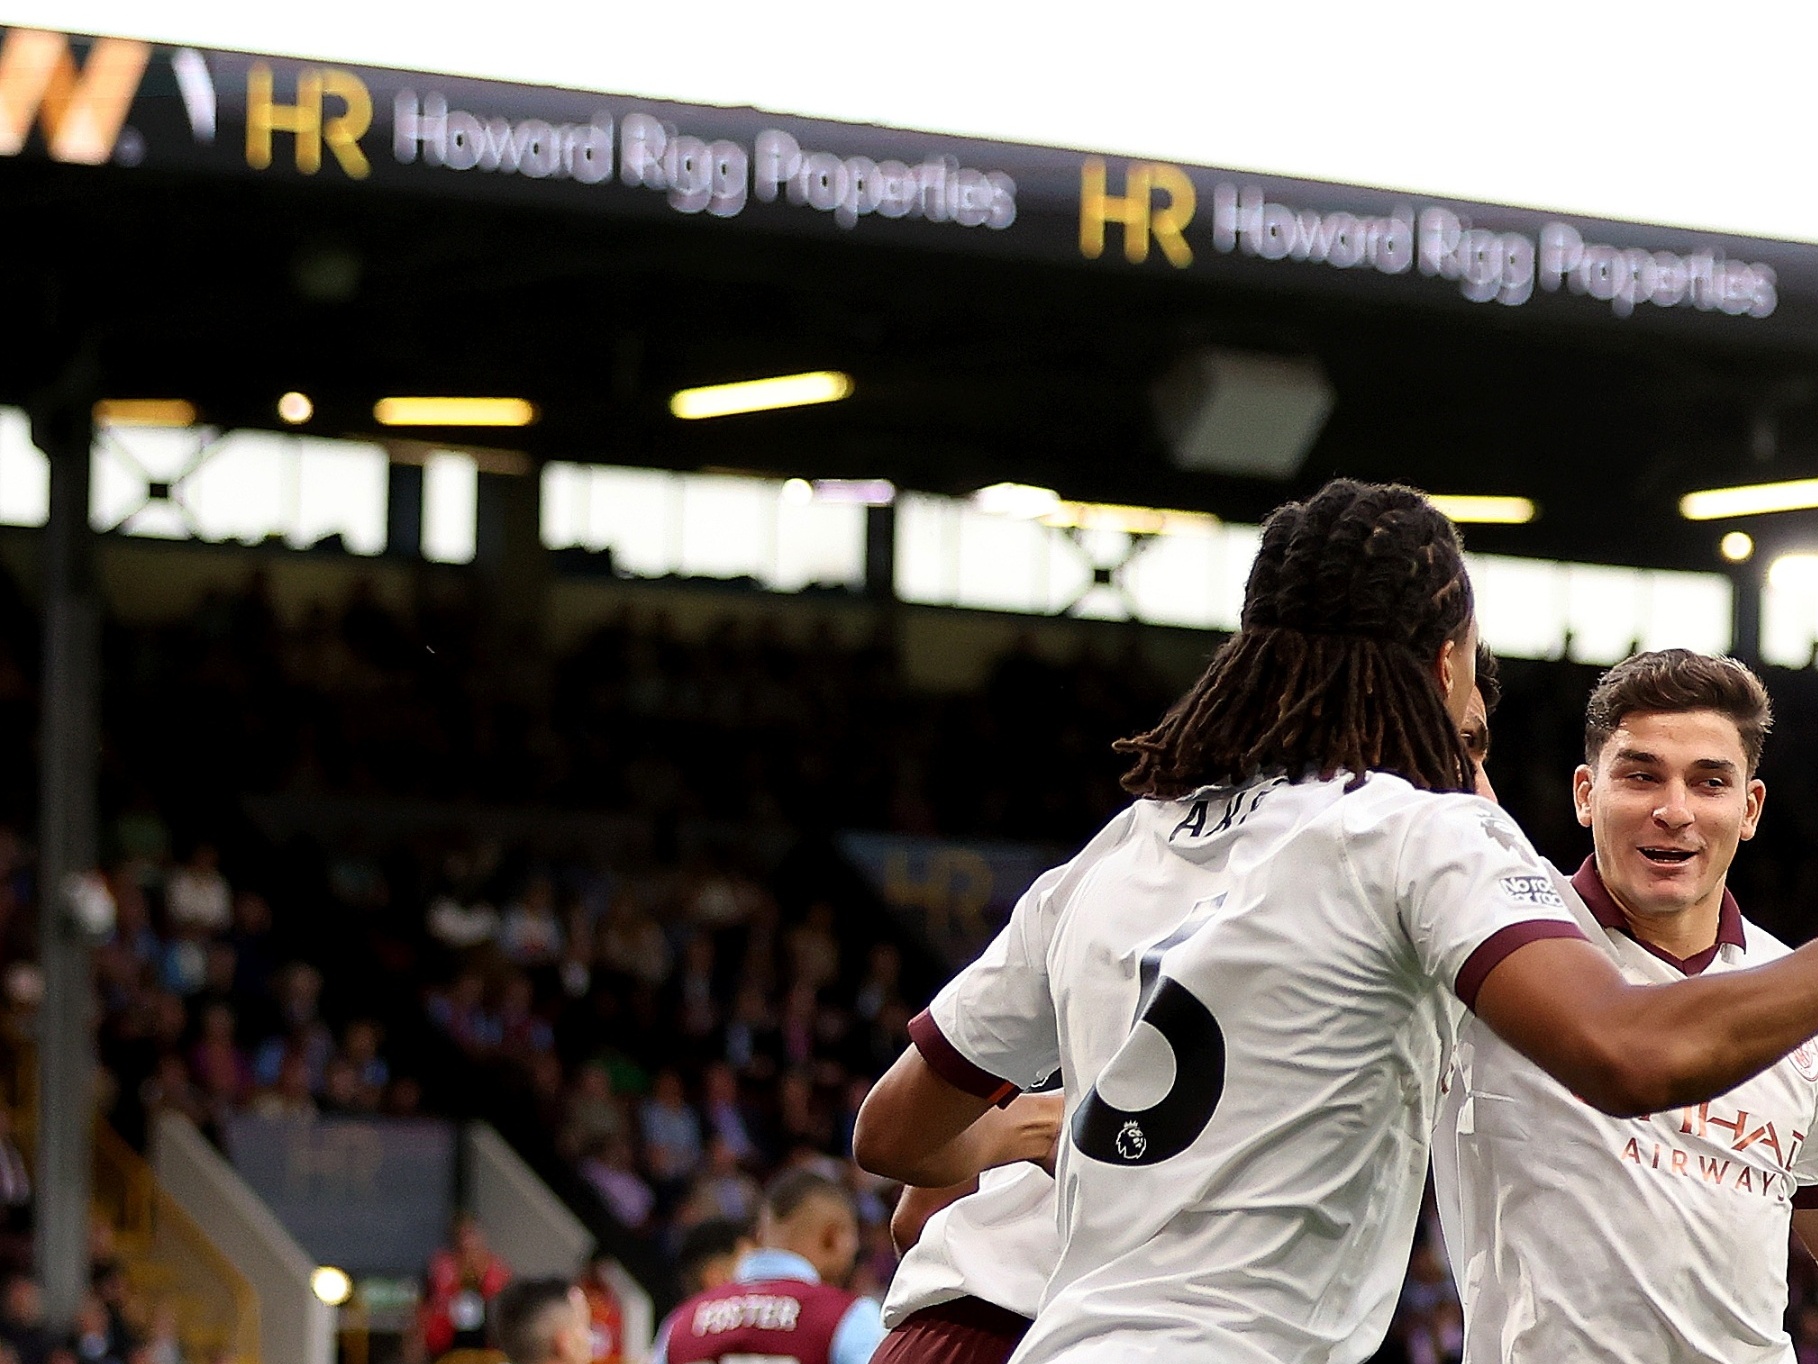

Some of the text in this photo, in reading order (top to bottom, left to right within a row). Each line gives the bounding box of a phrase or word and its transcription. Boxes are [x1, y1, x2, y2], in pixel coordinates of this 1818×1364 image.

[245, 62, 1017, 231] HR Howard Rigg Properties
[1079, 157, 1778, 319] HR Howard Rigg Properties
[692, 1293, 801, 1338] FOSTER
